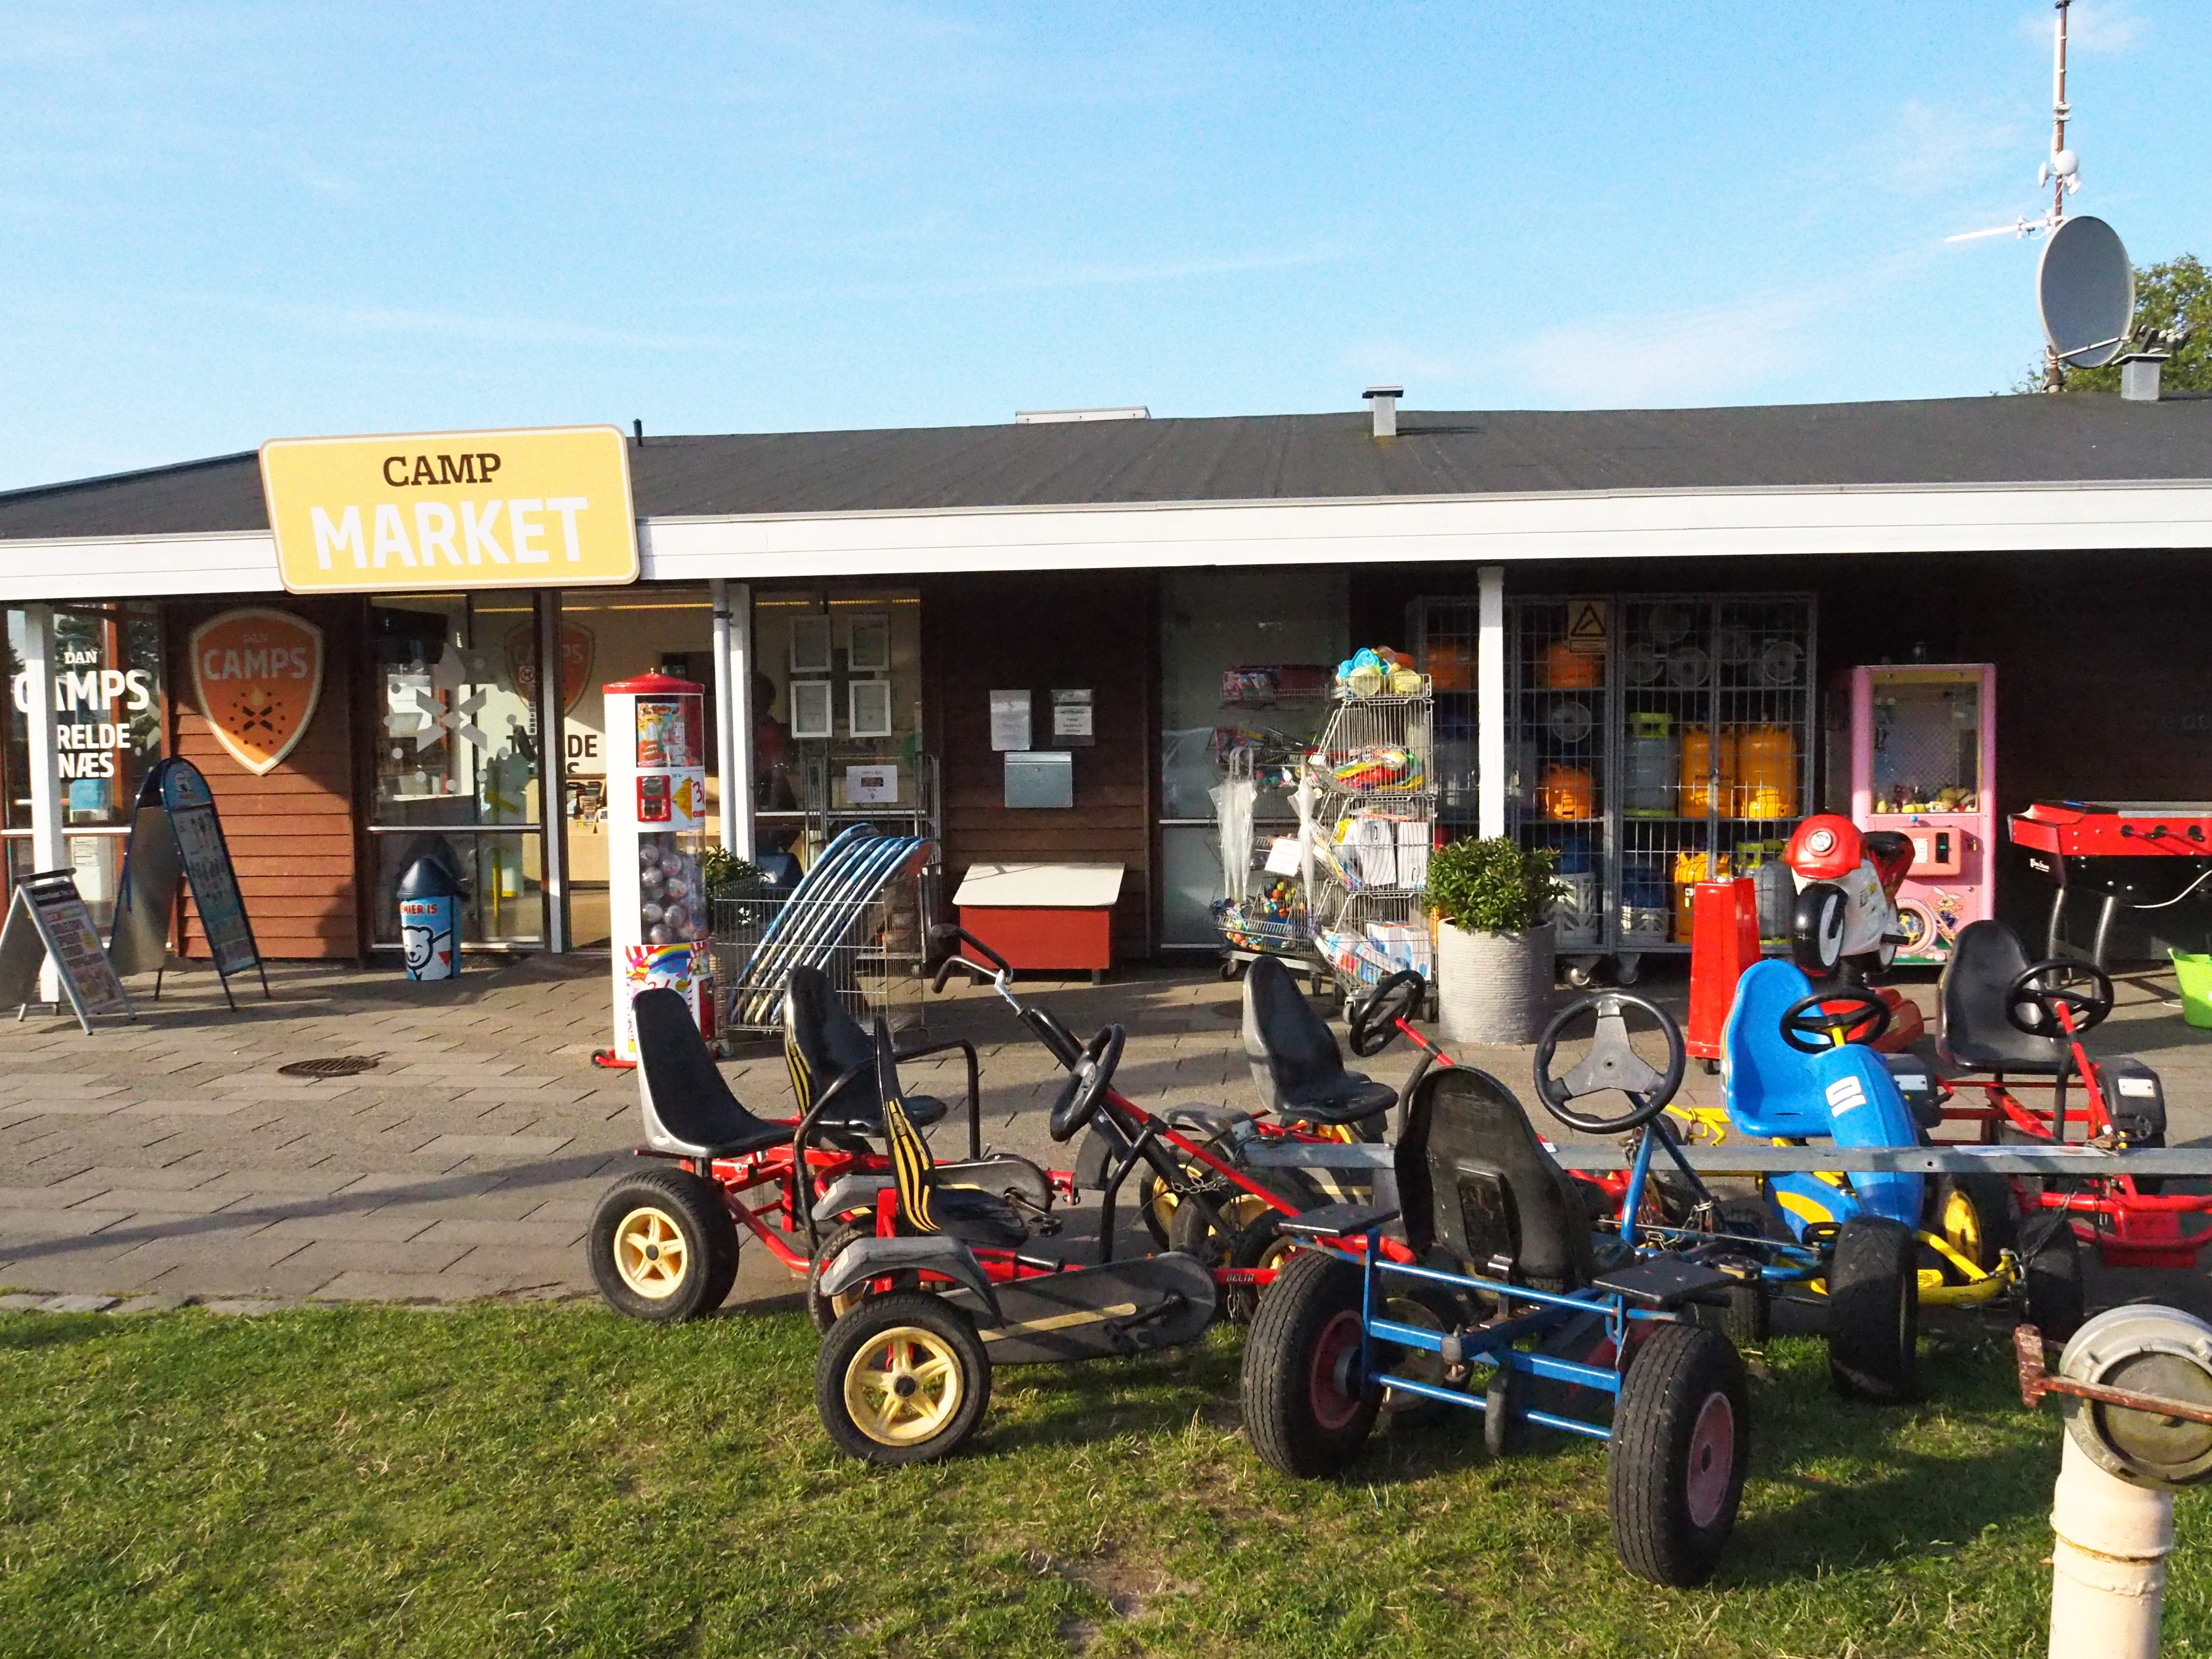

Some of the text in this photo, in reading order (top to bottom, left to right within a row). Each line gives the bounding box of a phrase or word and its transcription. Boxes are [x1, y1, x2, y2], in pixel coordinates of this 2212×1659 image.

[383, 453, 501, 487] CAMP
[310, 496, 588, 570] MARKET
[64, 651, 97, 664] DAN
[204, 648, 307, 680] CAMPS
[57, 723, 131, 750] RELDE
[58, 752, 115, 778] NÆS
[427, 904, 438, 914] IS
[1226, 1274, 1254, 1282] DELTA
